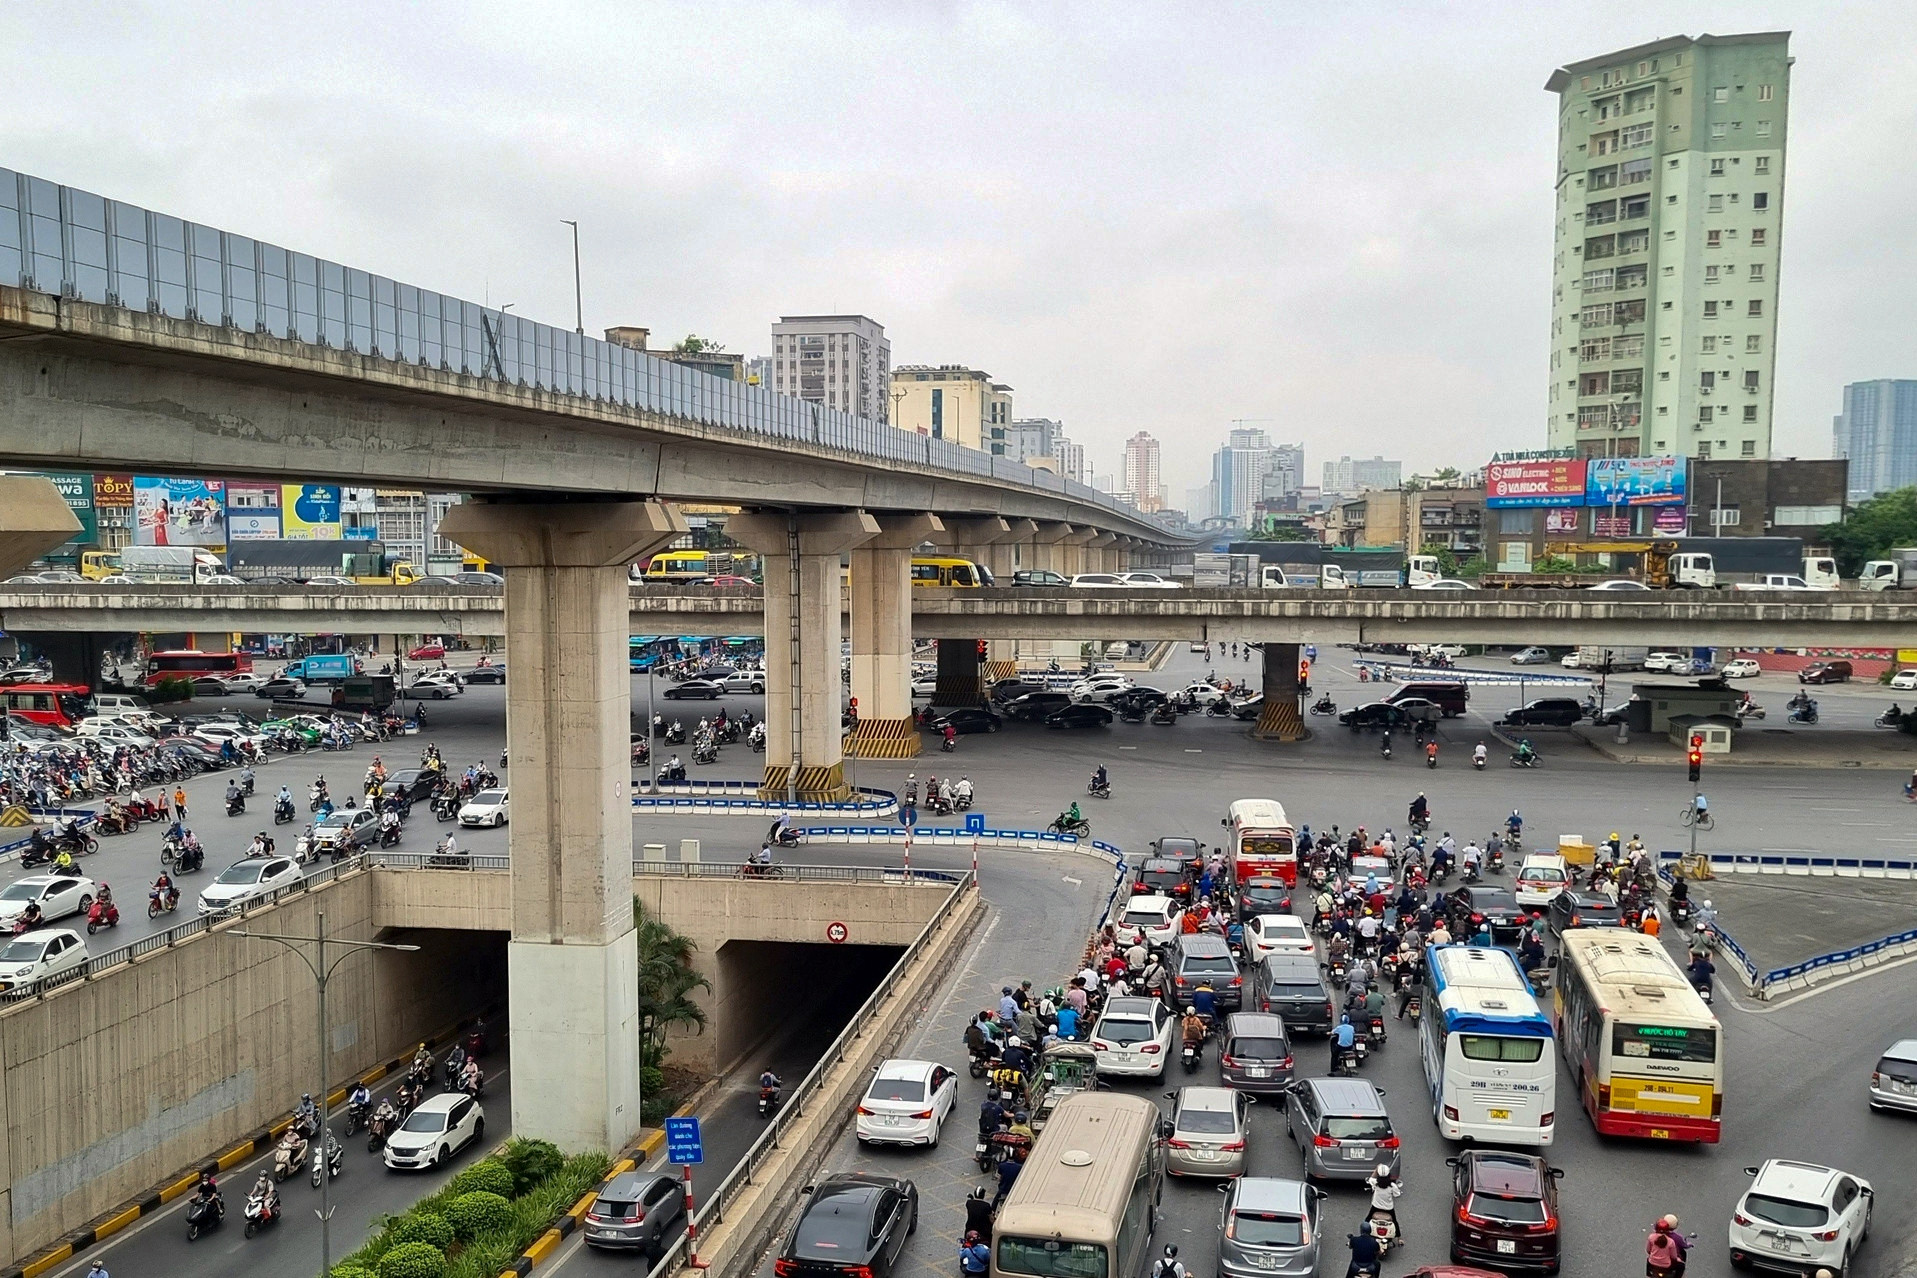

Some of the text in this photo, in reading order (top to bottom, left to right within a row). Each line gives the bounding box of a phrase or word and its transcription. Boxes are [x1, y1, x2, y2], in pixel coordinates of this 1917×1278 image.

[1503, 467, 1550, 478] SINO ELECTRIC
[1646, 1064, 1680, 1072] DAEWOO
[1470, 1080, 1487, 1088] 29B
[1512, 1083, 1540, 1092] 200.26
